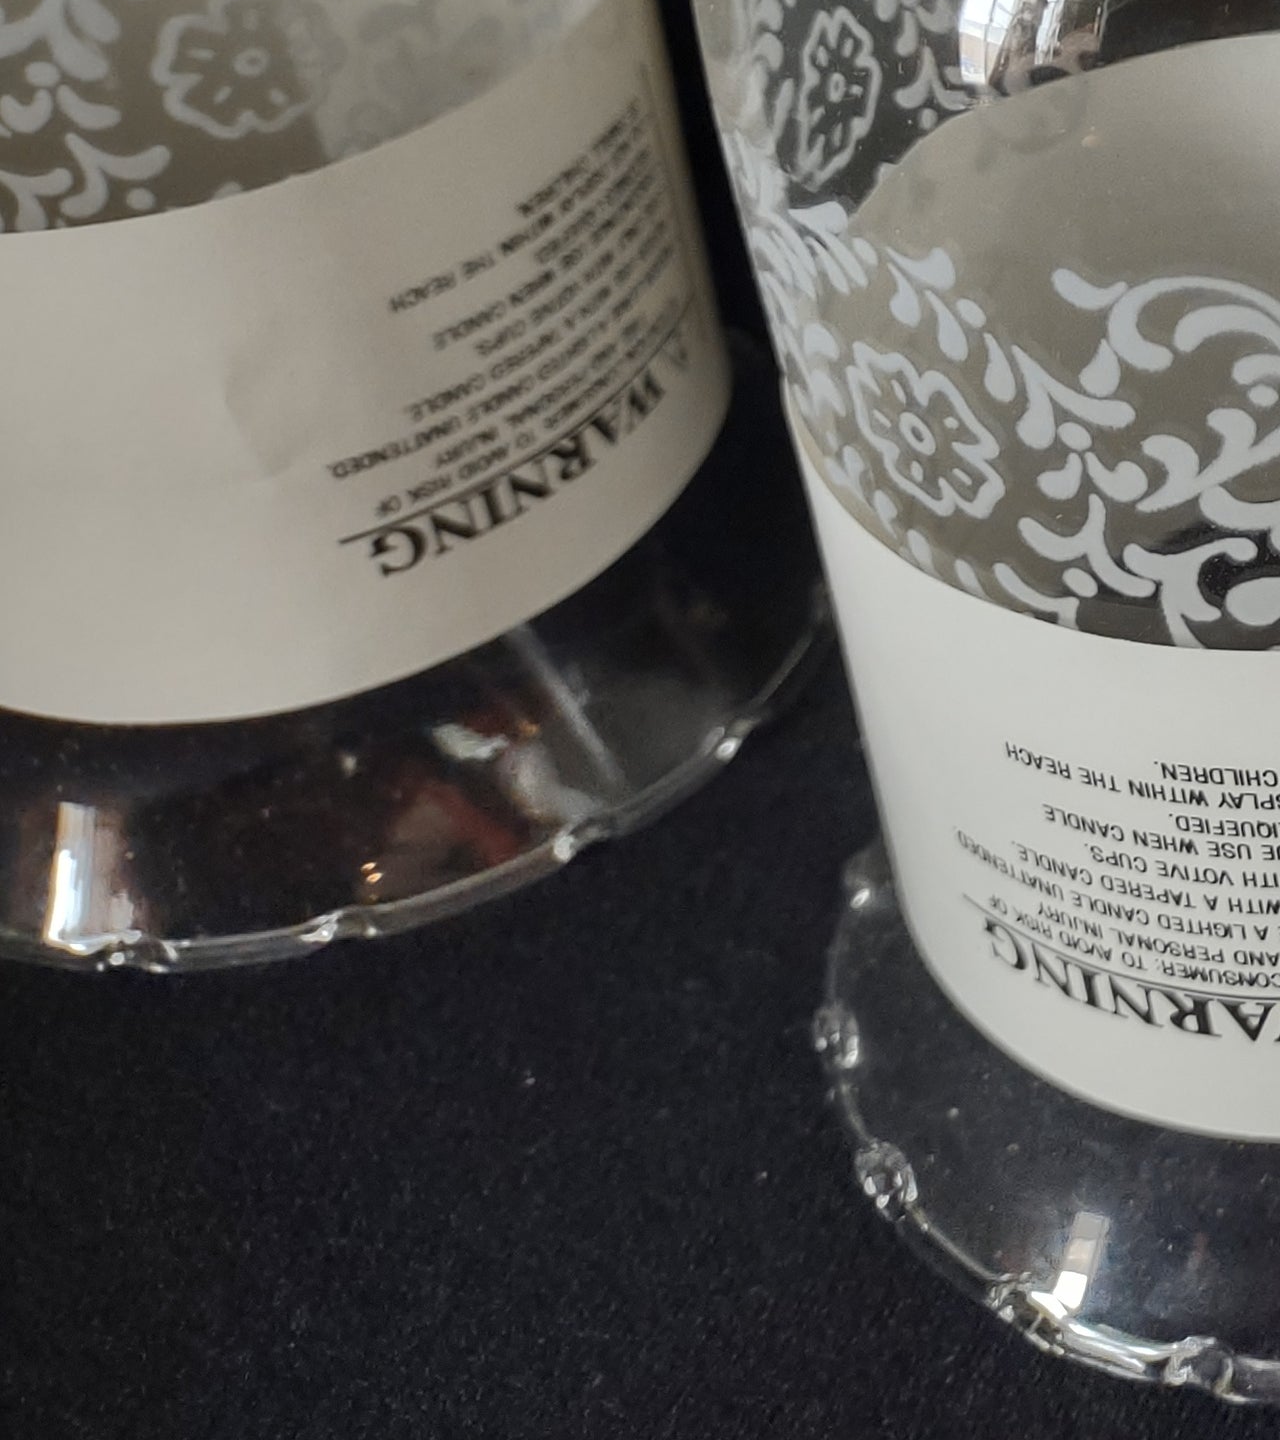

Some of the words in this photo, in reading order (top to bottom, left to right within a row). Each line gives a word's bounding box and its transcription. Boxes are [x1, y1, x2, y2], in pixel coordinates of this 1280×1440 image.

[367, 372, 665, 579] WARNING
[1005, 741, 1072, 780] REACH
[1152, 761, 1279, 788] CHILDREN.
[1077, 766, 1121, 794] THE
[1127, 779, 1209, 808] WITHIN
[1041, 803, 1125, 843] CANDLE
[1131, 829, 1199, 856] WHEN
[1205, 840, 1252, 860] USE
[1011, 841, 1093, 886] CANDLE.
[1083, 843, 1148, 874] CUPS.
[1154, 860, 1234, 887] VOTIVE
[988, 894, 1008, 916] OF
[1100, 874, 1197, 910] TAPERED
[1203, 894, 1219, 911] A
[1038, 901, 1103, 939] INJURY
[1070, 890, 1150, 926] CANDLE
[1015, 910, 1053, 940] RISK
[1157, 913, 1246, 940] LIGHTED
[1253, 925, 1269, 941] A
[1058, 930, 1113, 962] AVOID
[1109, 927, 1225, 964] PERSONAL
[1234, 949, 1280, 966] AND
[1122, 951, 1148, 971] TO
